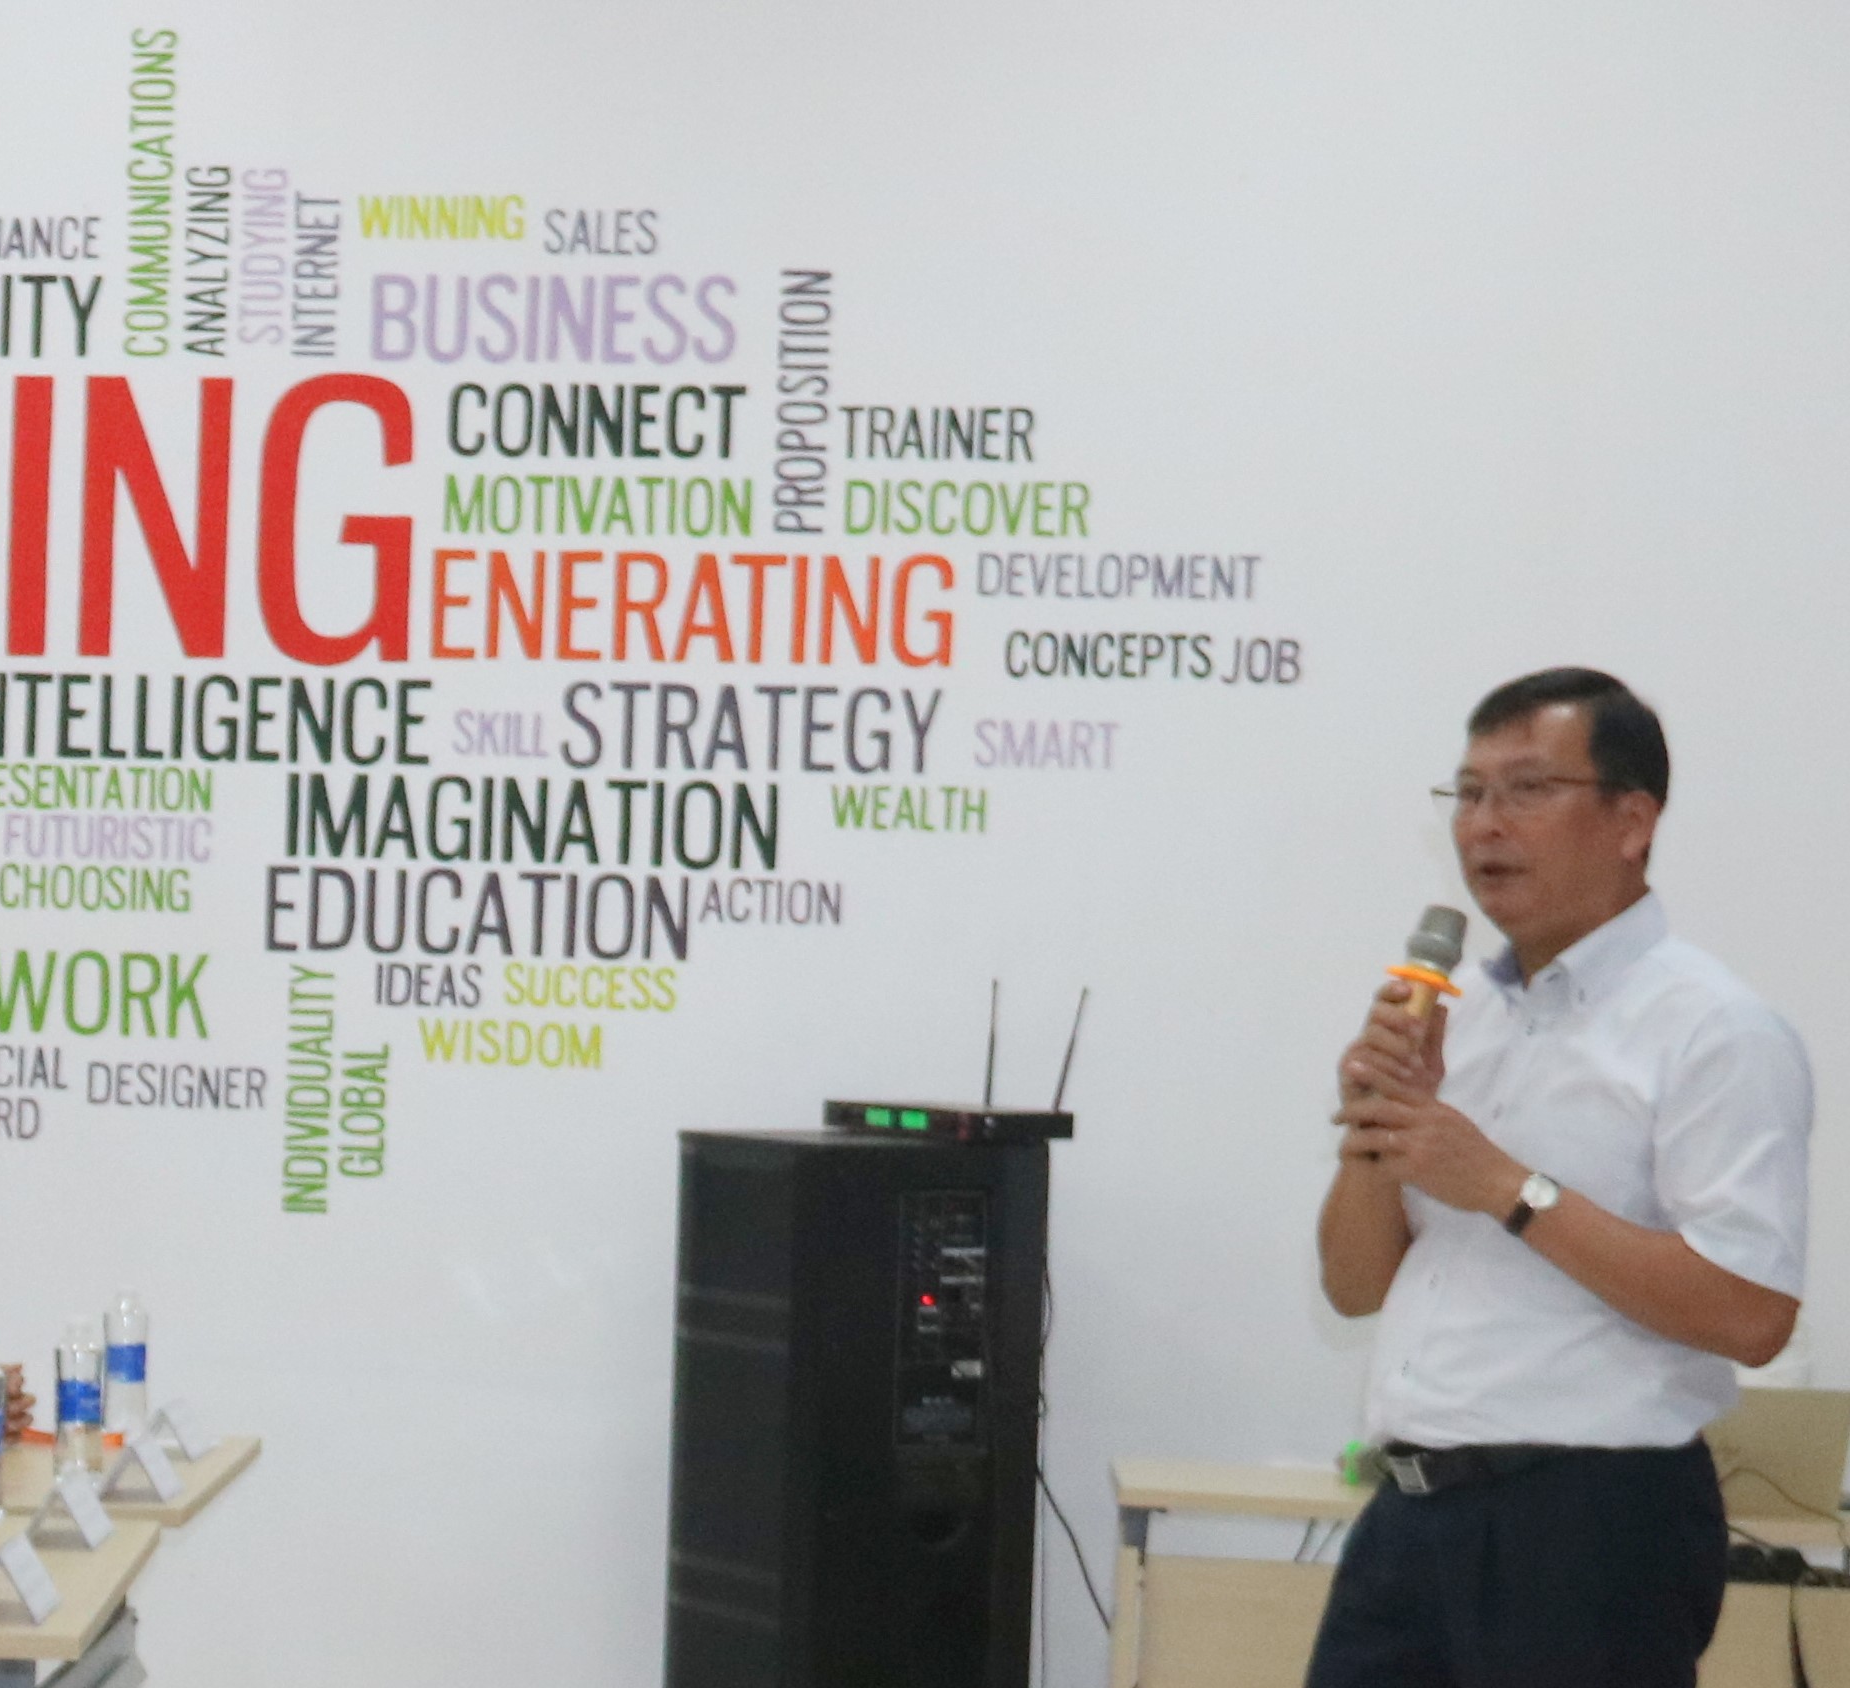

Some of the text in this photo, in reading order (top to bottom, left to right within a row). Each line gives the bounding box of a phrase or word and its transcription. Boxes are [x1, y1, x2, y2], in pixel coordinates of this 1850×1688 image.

[123, 28, 179, 358] COMMUNICATIONS
[358, 194, 526, 241] WINNING
[183, 165, 233, 357] ANALYZING
[238, 168, 289, 345] STUDYING
[545, 209, 657, 256] SALES
[292, 192, 340, 357] INTERNET
[371, 273, 737, 365] BUSINESS
[447, 381, 749, 461] CONNECT
[772, 269, 833, 535] PROPOSITION
[838, 405, 1036, 464] TRAINER
[5, 373, 414, 668] ING
[443, 473, 754, 539] MOTIVATION
[844, 478, 1091, 538] DISCOVER
[977, 553, 1260, 600] DEVELOPMENT
[429, 547, 957, 669] ENERATING
[1004, 629, 1214, 680] CONCEPTS
[1221, 637, 1302, 685] JOB
[452, 709, 548, 759] SKILL
[560, 680, 943, 776] STRATEGY
[973, 720, 1118, 769] SMART
[3, 813, 211, 863] FUTURISTIC
[285, 771, 780, 872] IMAGINATION
[831, 785, 988, 833] WEALTH
[265, 864, 691, 963] EDUCATION
[699, 877, 842, 925] ACTION
[375, 962, 483, 1009] IDEAS
[504, 961, 677, 1013] SUCCESS
[418, 1018, 603, 1070] WISDOM
[87, 1061, 267, 1110] DESIGNER
[282, 964, 335, 1215] INDIVIDUALITY
[337, 1043, 391, 1179] GLOBAL
